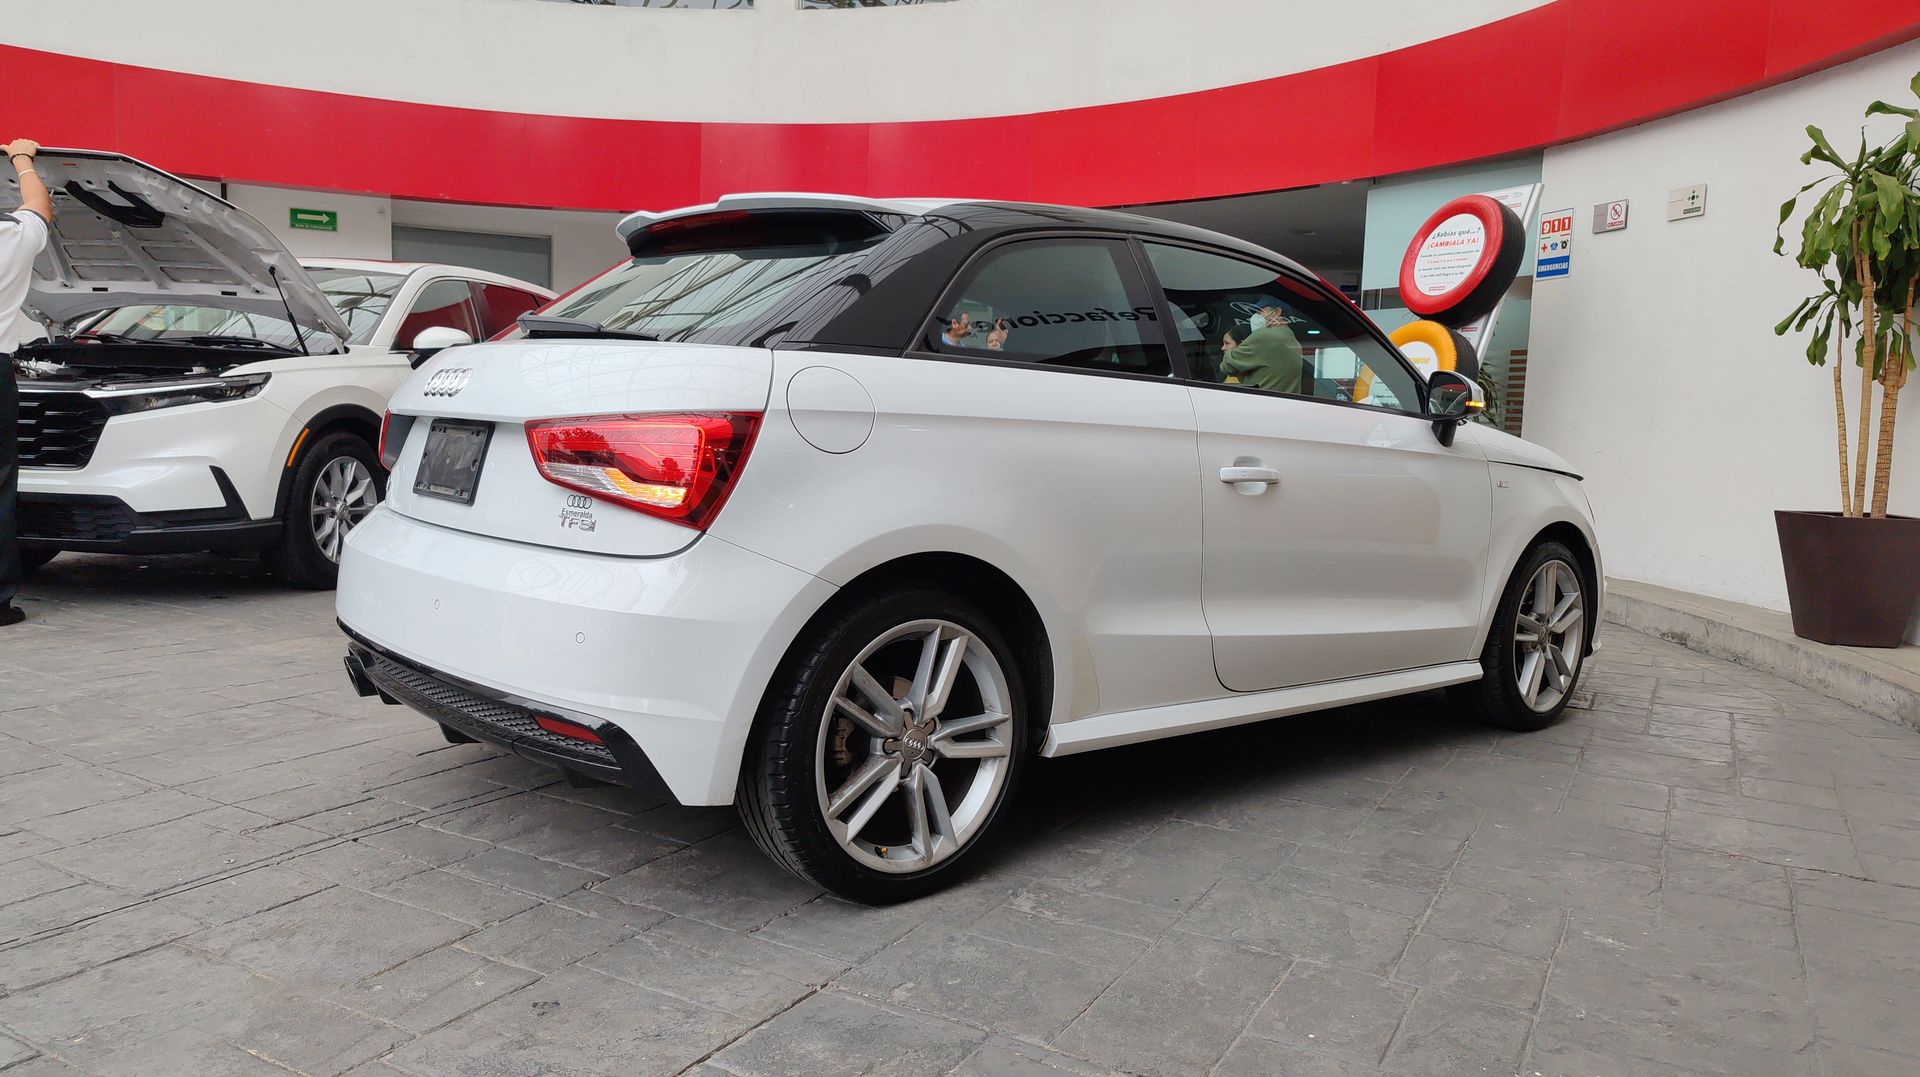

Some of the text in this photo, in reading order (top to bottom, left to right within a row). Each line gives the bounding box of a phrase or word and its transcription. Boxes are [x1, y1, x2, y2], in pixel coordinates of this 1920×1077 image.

[1542, 218, 1570, 234] 911
[561, 507, 593, 519] Esmeralda
[558, 514, 597, 532] TFSI
